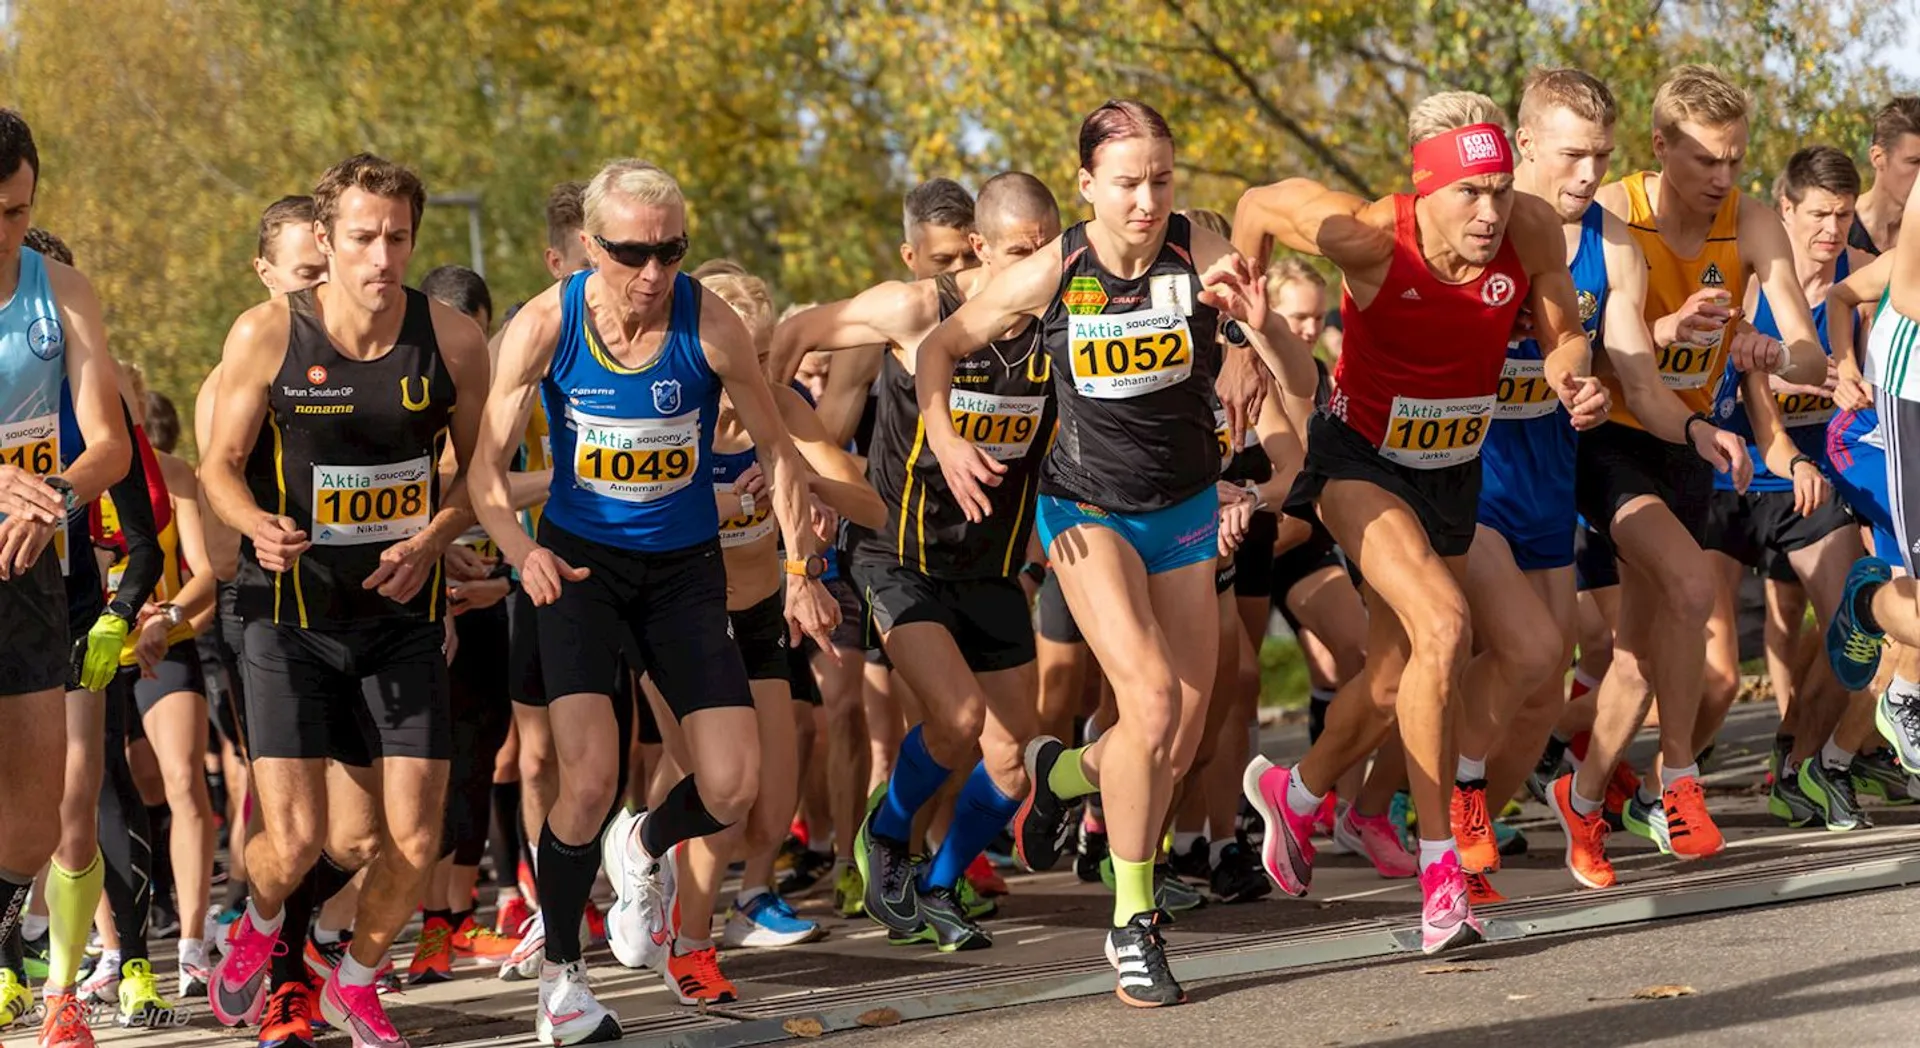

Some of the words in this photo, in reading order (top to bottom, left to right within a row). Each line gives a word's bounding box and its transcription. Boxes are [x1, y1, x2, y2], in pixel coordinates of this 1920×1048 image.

[1462, 133, 1494, 147] KOTI
[1075, 322, 1123, 338] Aktia
[1126, 315, 1170, 329] saucony
[1080, 333, 1184, 375] 1052
[1111, 374, 1158, 388] Johanna
[282, 386, 307, 397] Turun
[309, 387, 341, 397] Seudun
[341, 387, 354, 397] OP
[295, 404, 355, 414] noname
[956, 396, 996, 413] Aktia
[999, 402, 1031, 410] saucony
[1398, 404, 1442, 418] Aktia
[1445, 403, 1482, 413] saucony
[5, 426, 45, 440] saucony
[955, 413, 1032, 443] 1019
[1397, 417, 1483, 450] 1018
[585, 429, 632, 449] Aktia
[636, 432, 681, 444] saucony
[0, 441, 52, 475] 16
[586, 448, 689, 481] 1049
[1419, 452, 1450, 461] Jarkko
[322, 473, 371, 488] Aktia
[374, 467, 416, 481] saucony
[609, 483, 662, 492] Annemari
[324, 484, 421, 523] 1008
[357, 524, 388, 533] Niklas
